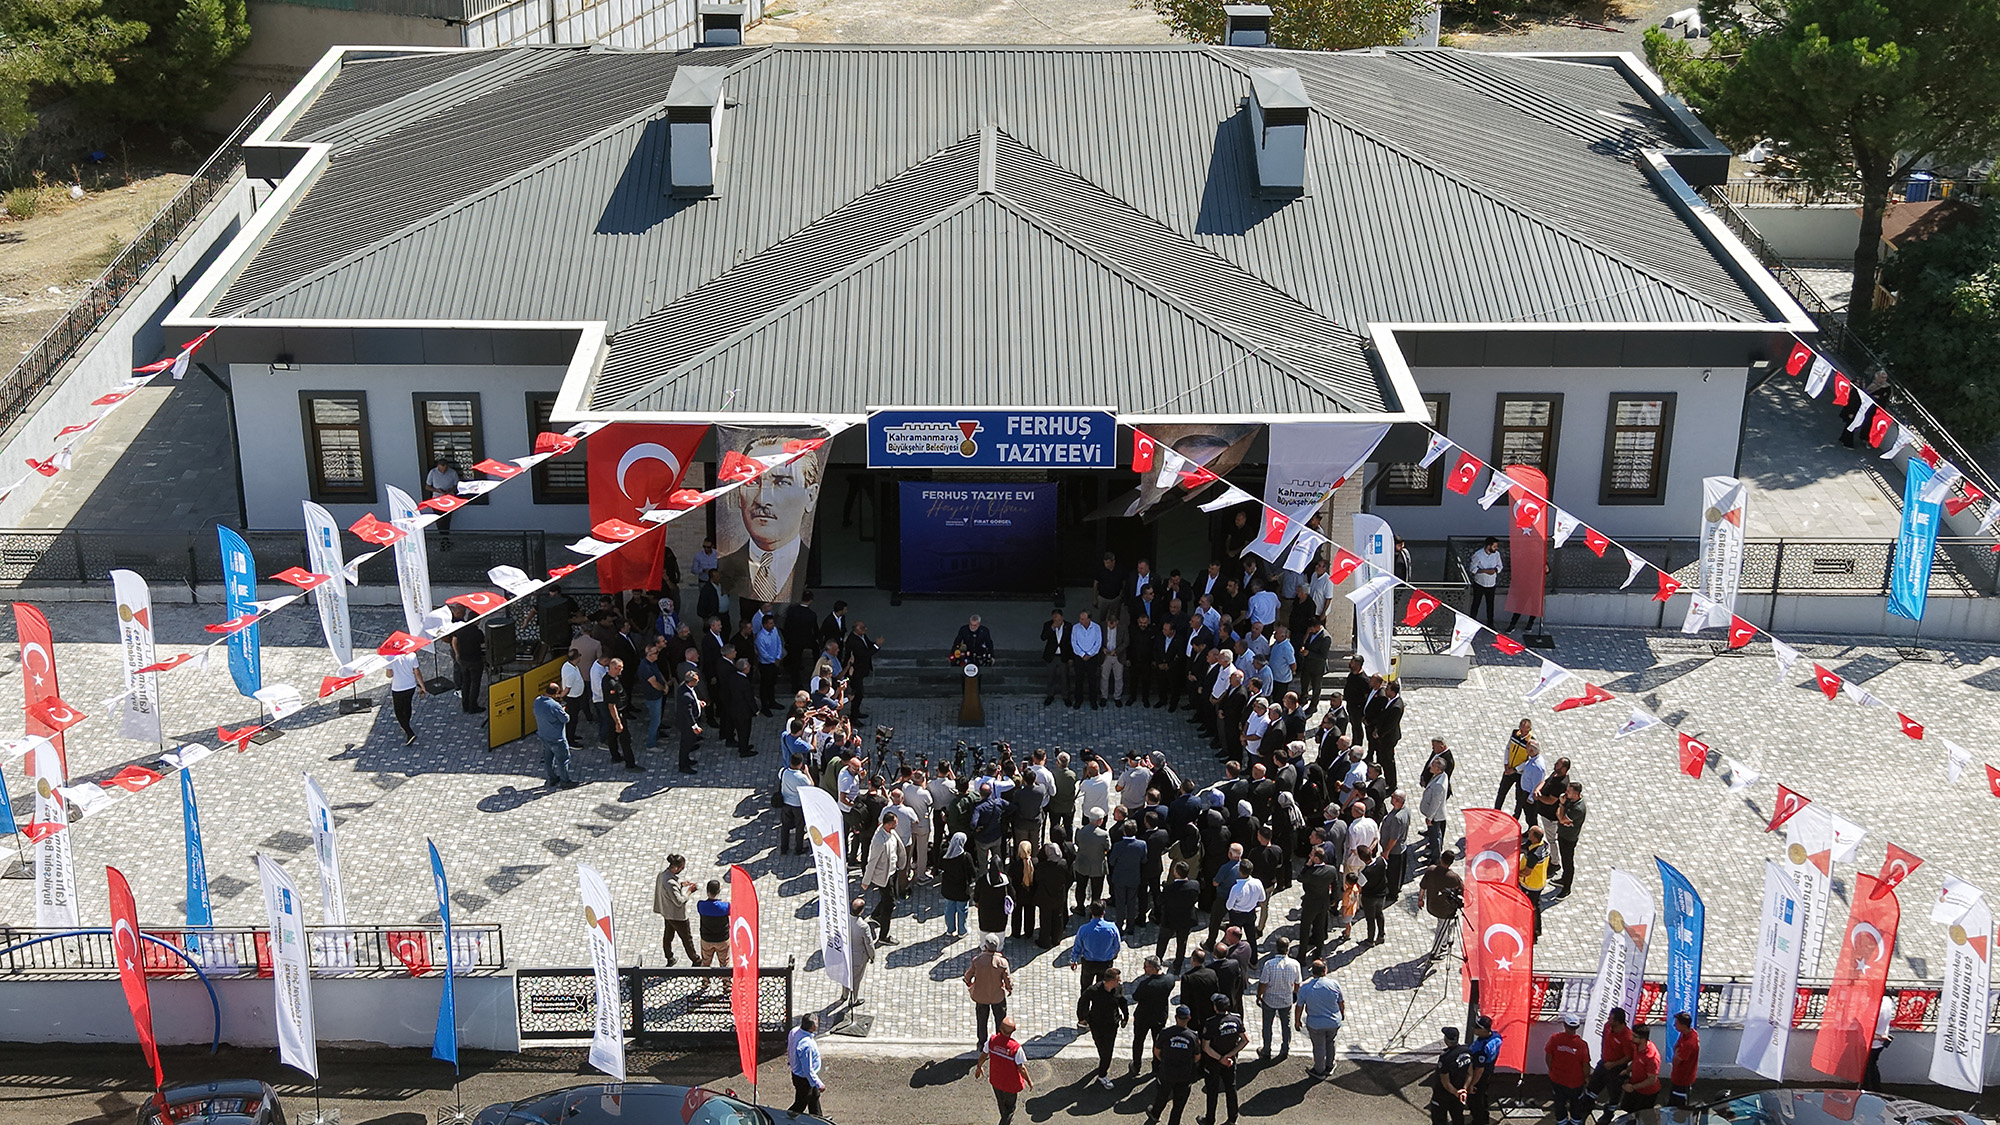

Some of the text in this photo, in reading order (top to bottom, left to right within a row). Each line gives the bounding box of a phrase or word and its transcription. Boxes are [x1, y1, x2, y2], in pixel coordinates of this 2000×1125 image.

[1007, 416, 1092, 440] FERHUŞ
[889, 433, 959, 443] Kahramanmaraş
[888, 443, 959, 454] Büyükşehir Belediyesi
[922, 490, 968, 501] FERHUŞ
